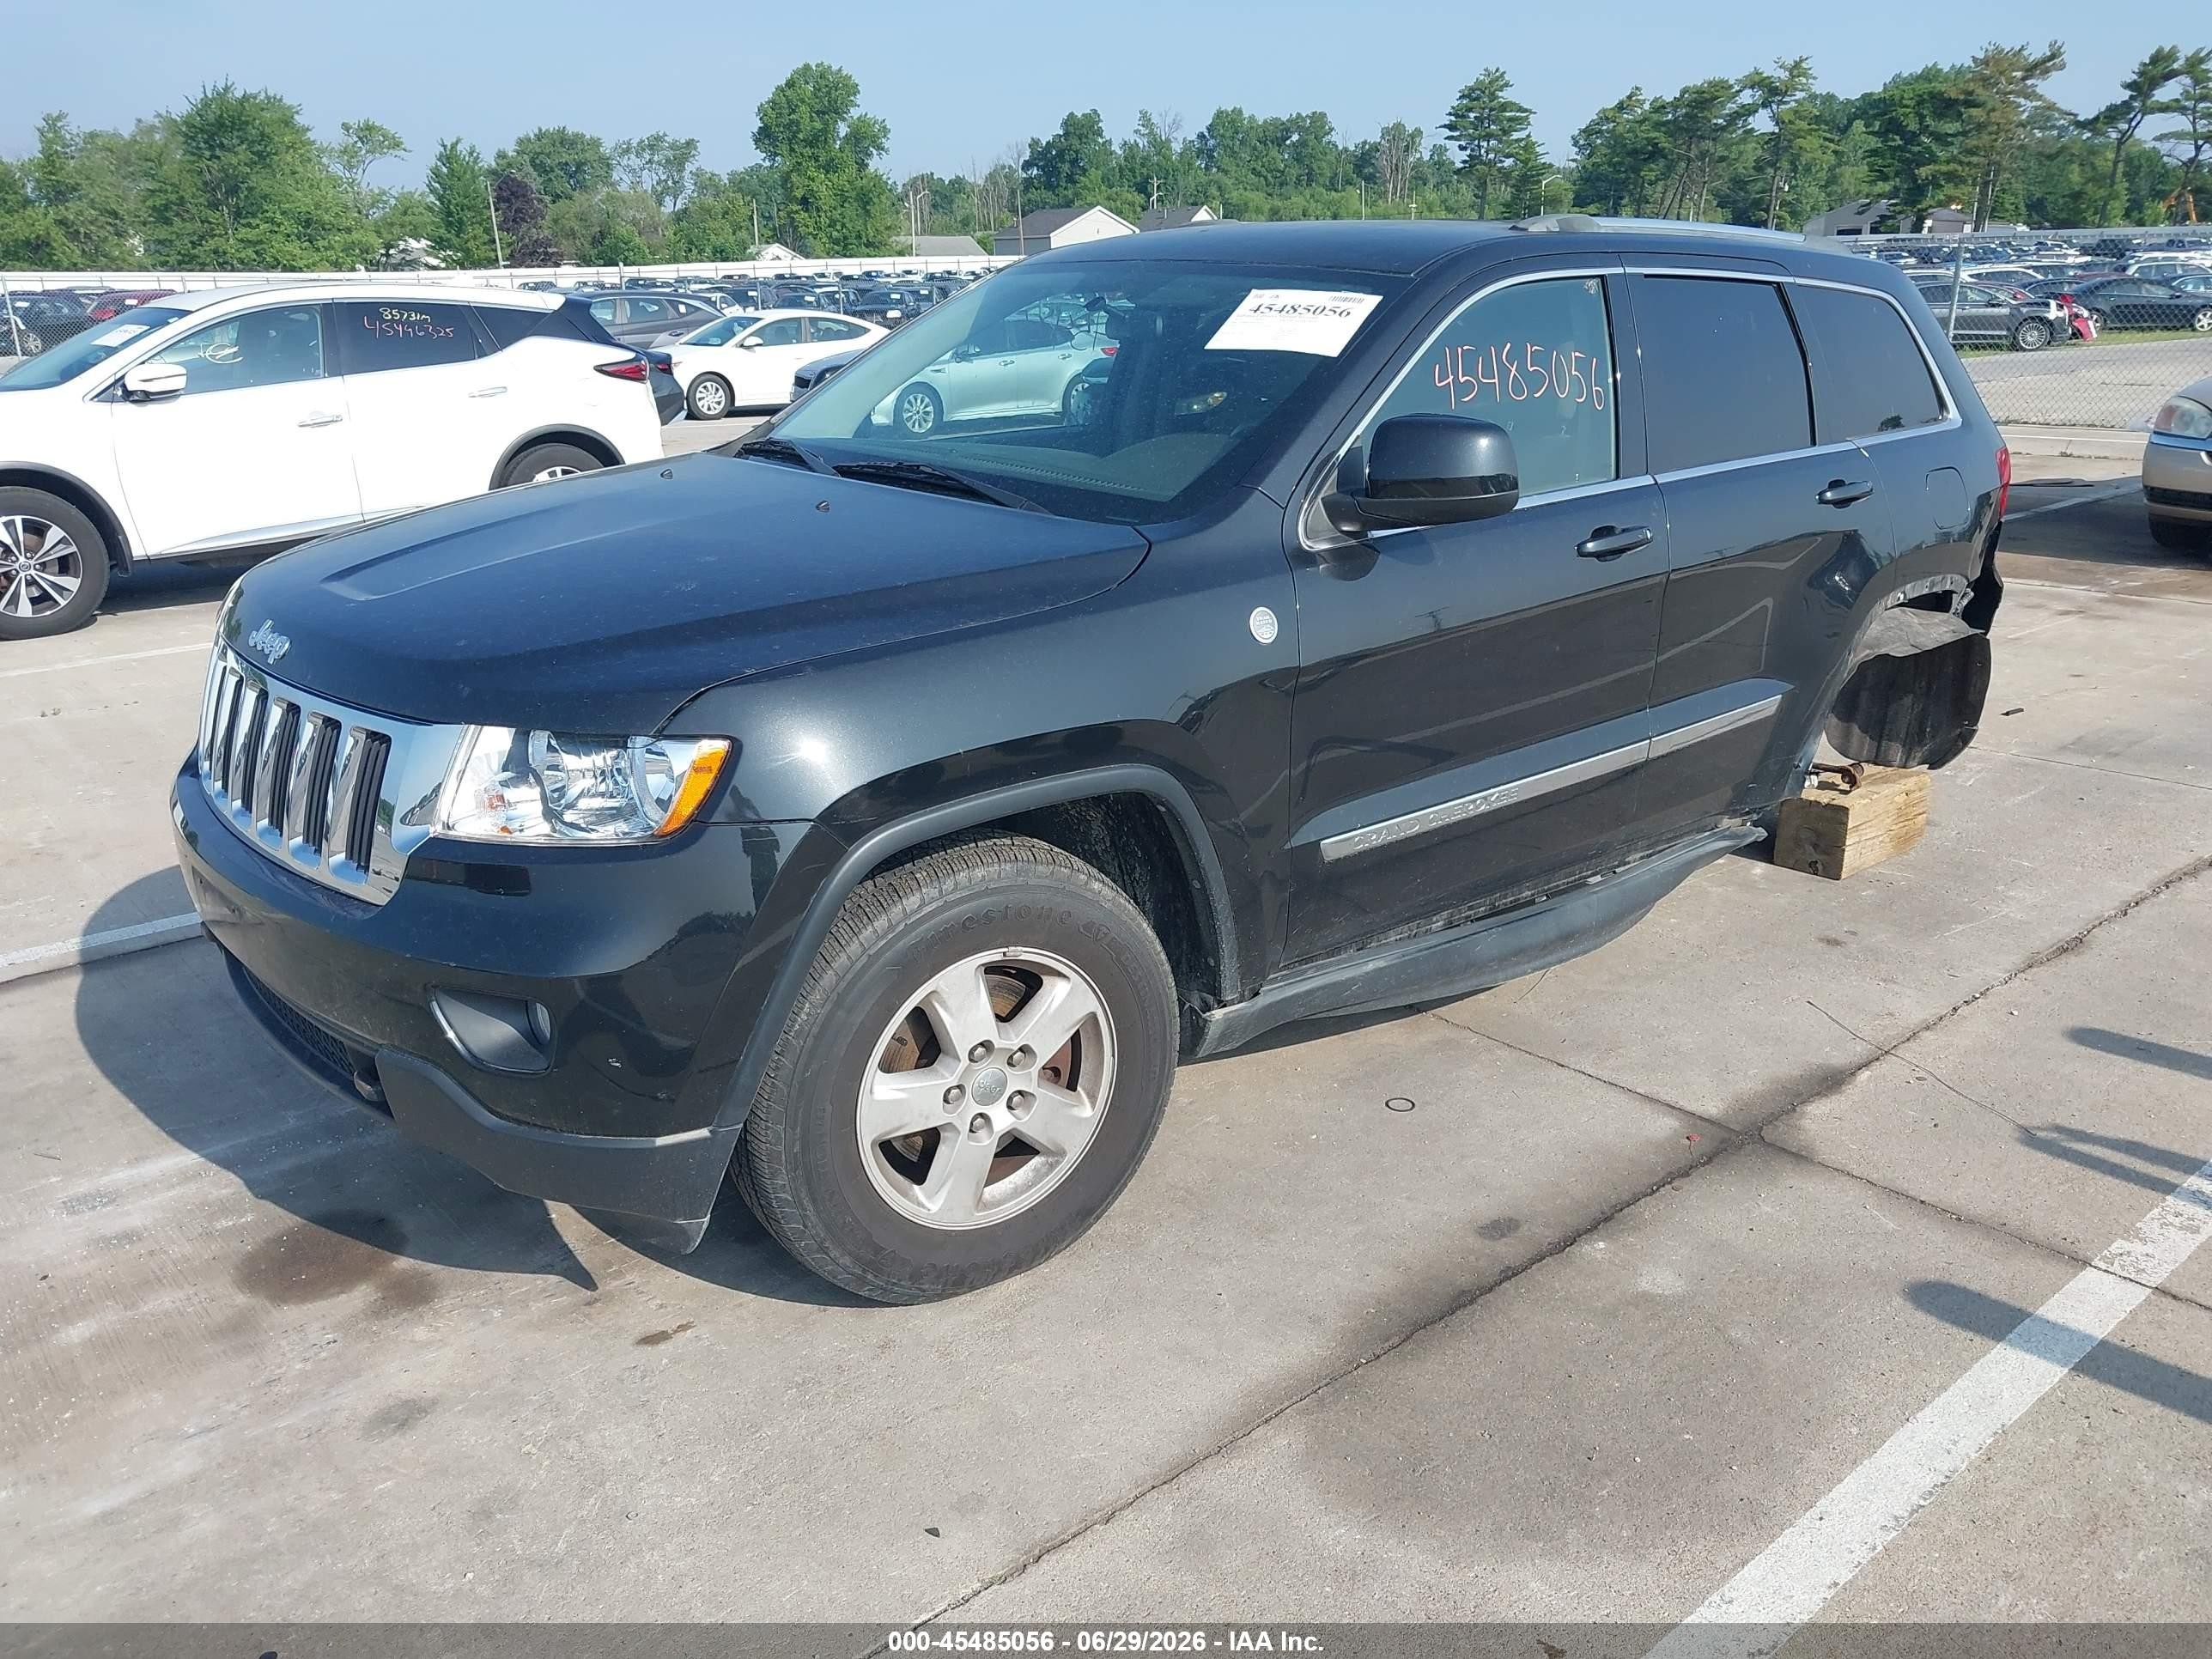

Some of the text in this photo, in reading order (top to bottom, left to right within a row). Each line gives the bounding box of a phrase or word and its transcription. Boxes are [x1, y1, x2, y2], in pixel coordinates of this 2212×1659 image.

[1249, 302, 1351, 318] 45485056
[1433, 342, 1605, 410] 45485056
[248, 618, 291, 665] Jeep
[1352, 787, 1519, 850] GRAND CHEROKEE
[905, 903, 1073, 963] Firestone
